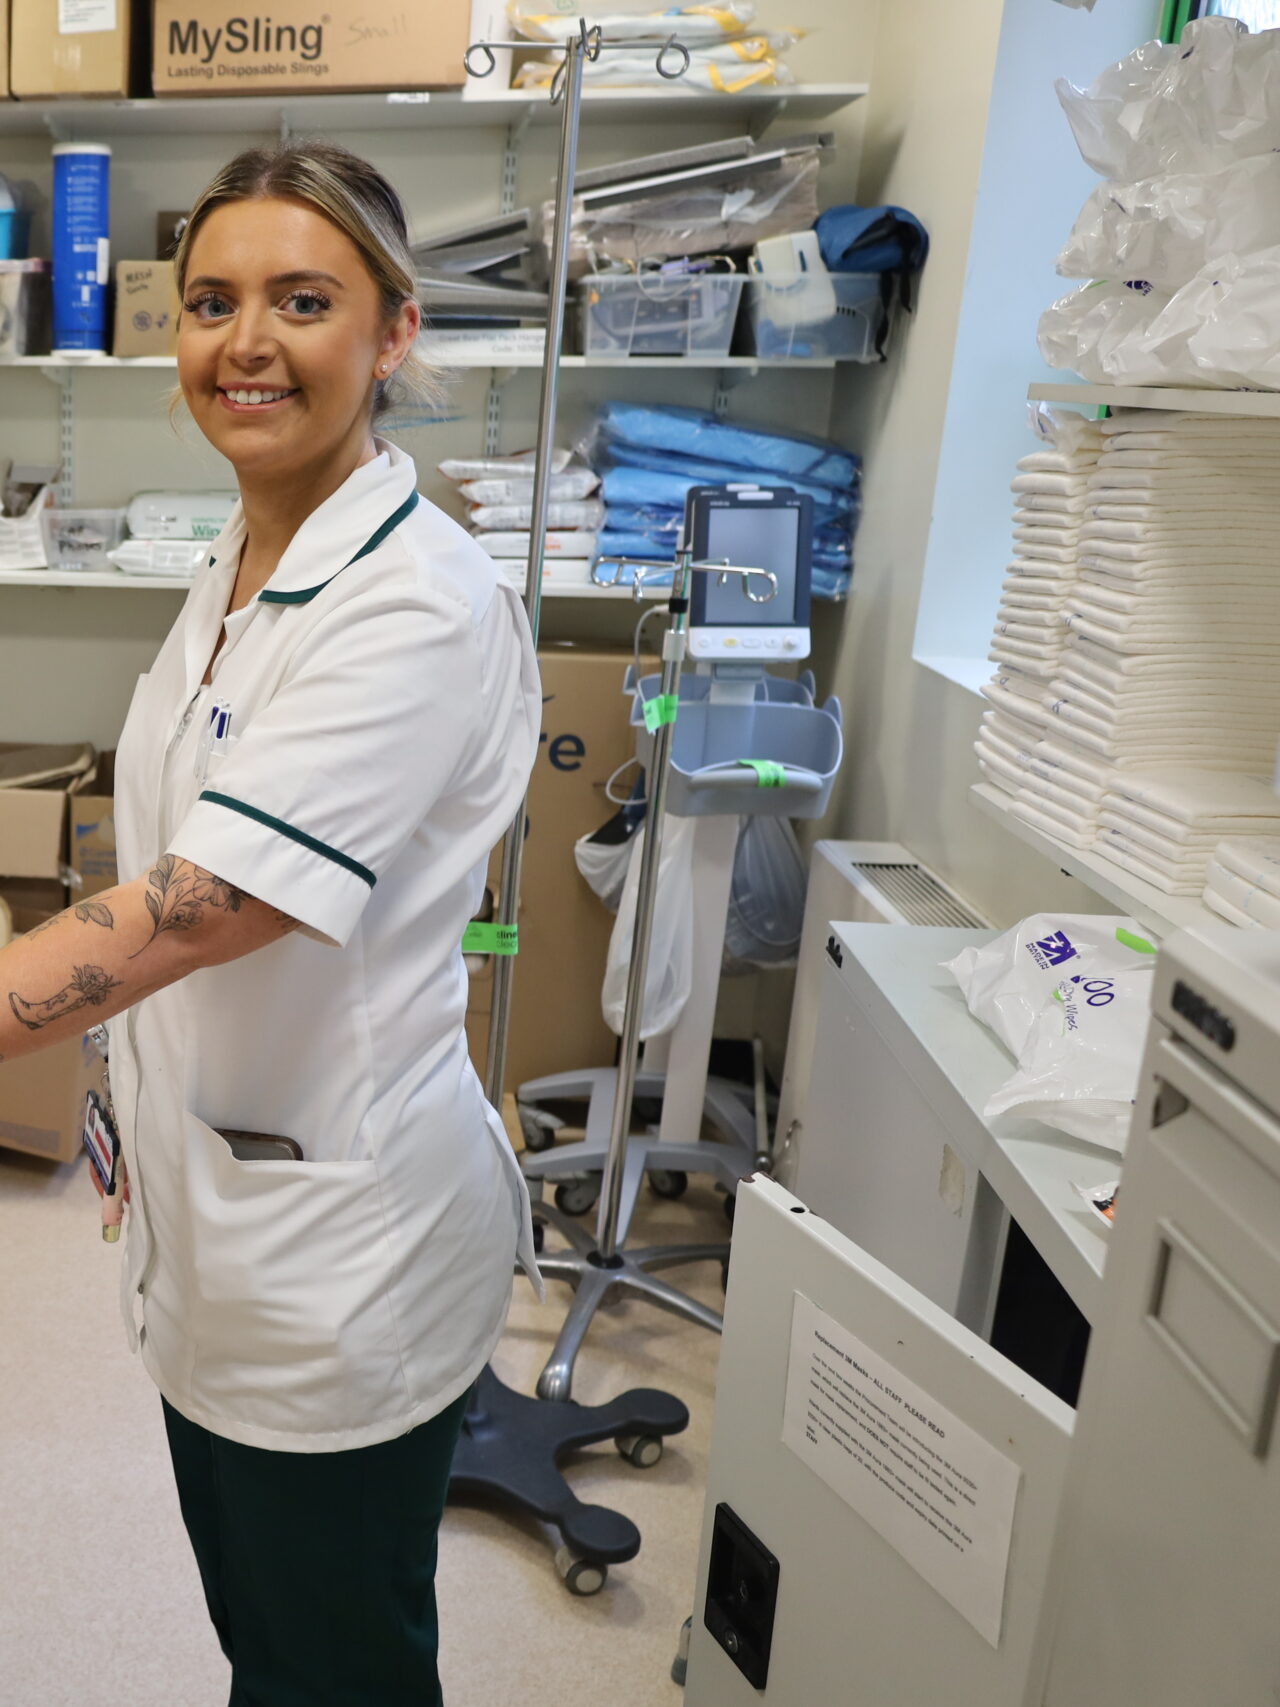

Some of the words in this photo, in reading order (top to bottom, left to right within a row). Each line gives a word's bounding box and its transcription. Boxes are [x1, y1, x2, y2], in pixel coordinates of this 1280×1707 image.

[169, 17, 322, 63] MySling
[167, 64, 214, 78] Lasting
[217, 62, 287, 77] Disposable
[290, 61, 330, 75] Slings
